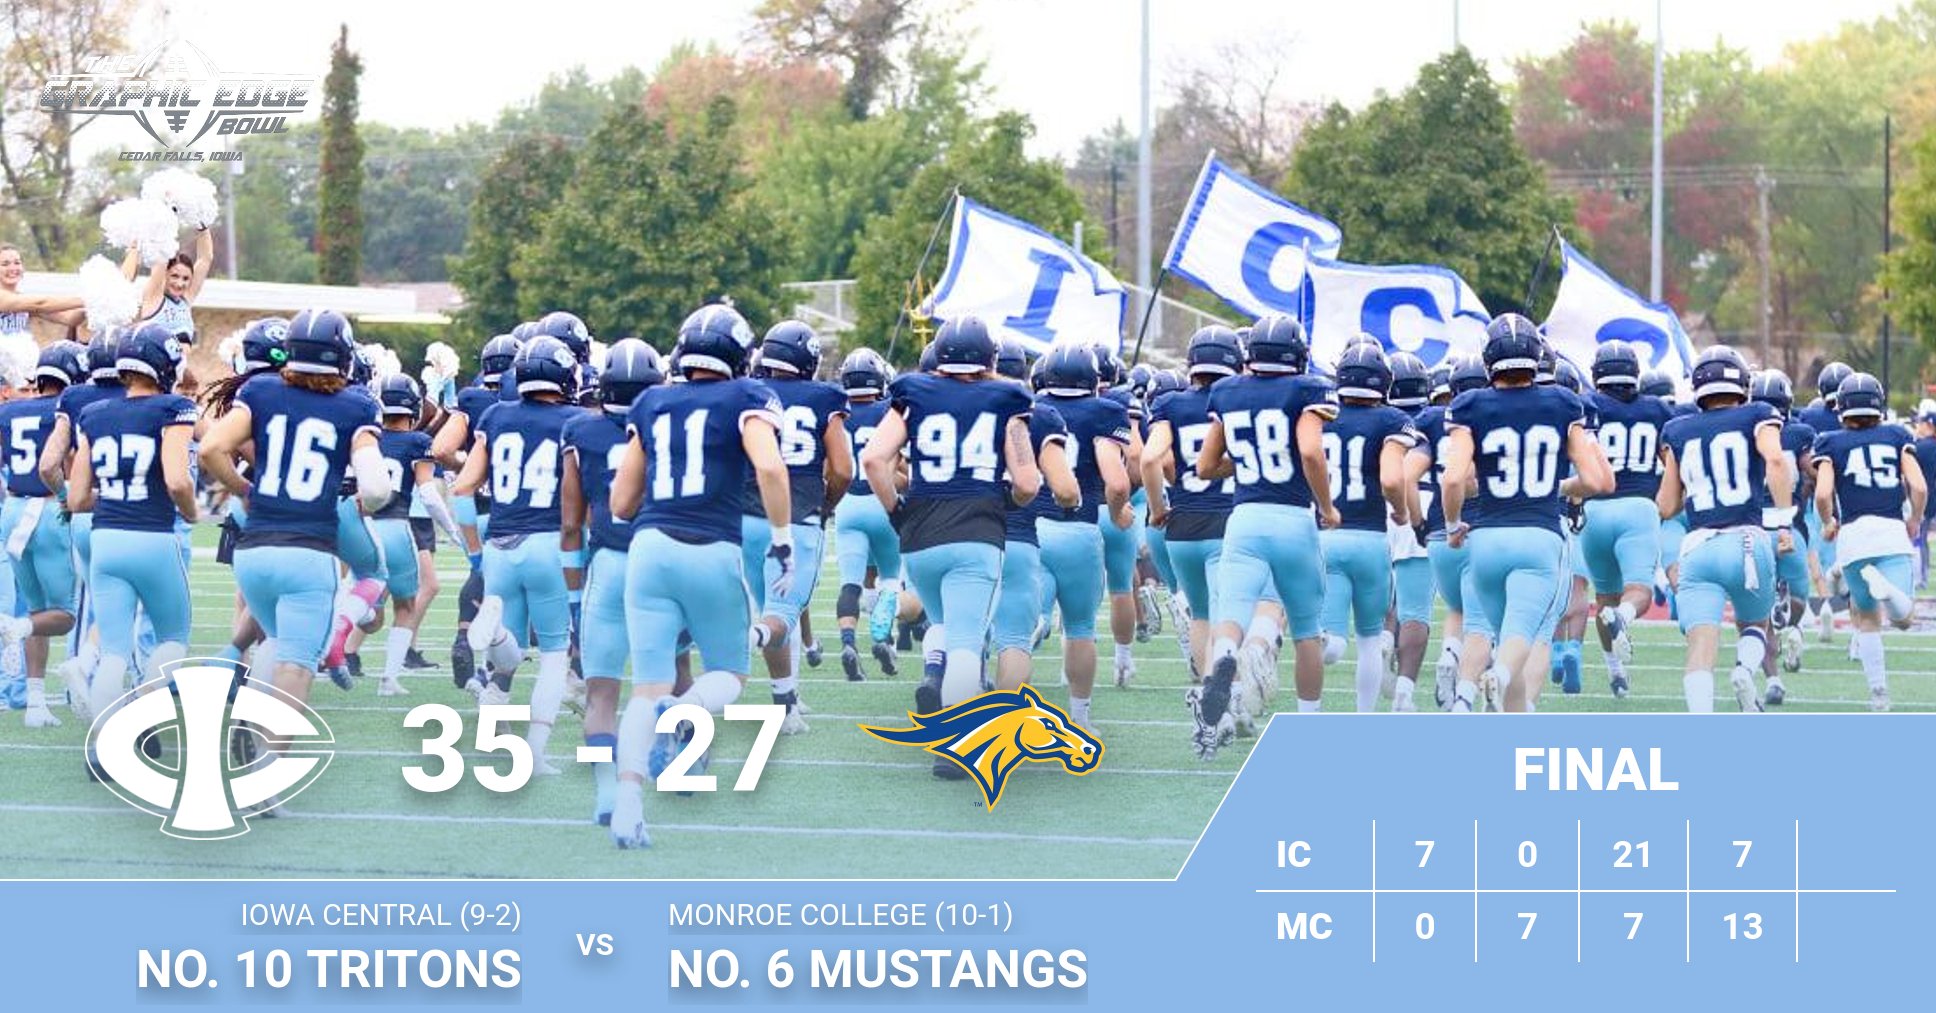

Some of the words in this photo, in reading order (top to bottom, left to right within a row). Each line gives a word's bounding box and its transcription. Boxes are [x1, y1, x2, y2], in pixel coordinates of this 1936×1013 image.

[1002, 247, 1076, 343] I
[1360, 287, 1450, 368] C
[11, 416, 41, 475] 5
[91, 434, 155, 501] 27
[255, 414, 338, 502] 16
[491, 432, 558, 508] 84
[652, 409, 710, 500] 11
[917, 412, 998, 483] 94
[1222, 408, 1294, 485] 58
[1482, 425, 1561, 499] 30
[1598, 422, 1657, 473] 90
[1680, 431, 1753, 511] 40
[1844, 444, 1900, 489] 45
